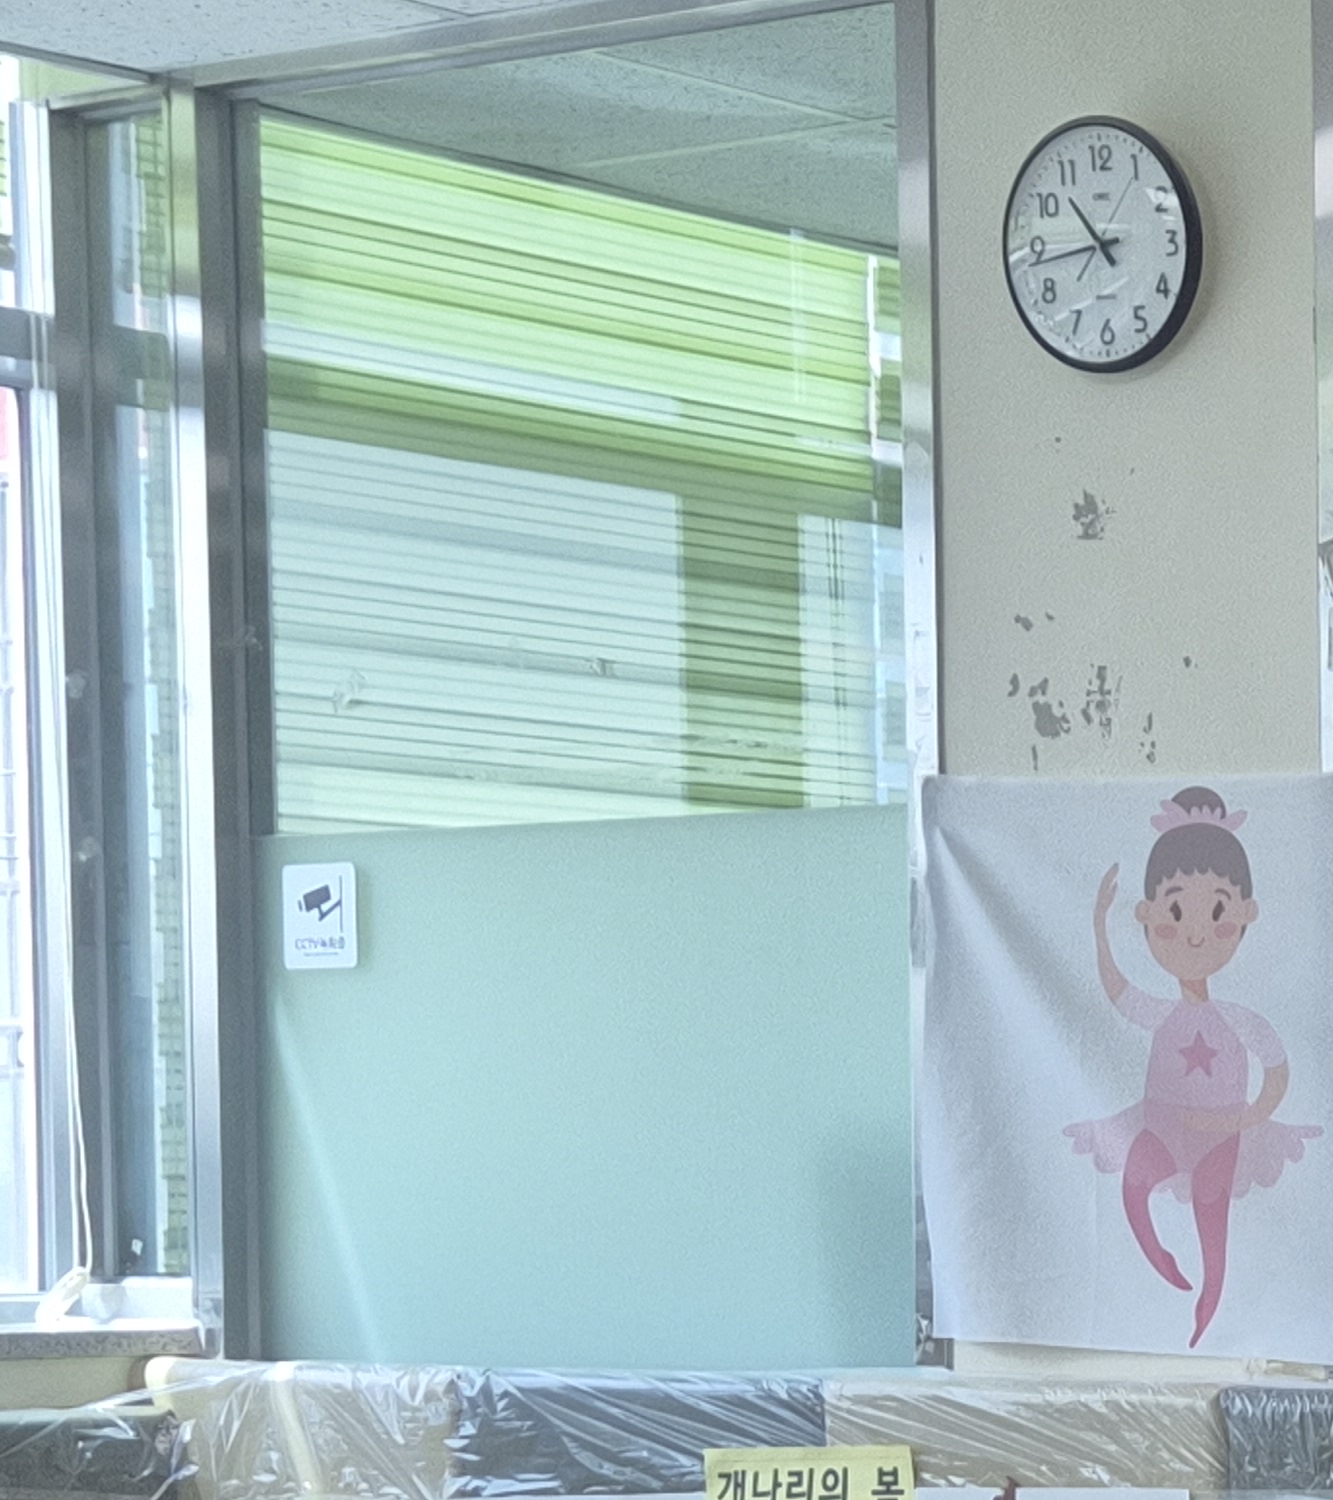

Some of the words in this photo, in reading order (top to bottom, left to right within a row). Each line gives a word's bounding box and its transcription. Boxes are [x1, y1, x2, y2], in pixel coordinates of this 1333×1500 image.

[1088, 144, 1113, 172] 12
[1130, 153, 1139, 181] 1
[1058, 159, 1076, 186] 11
[1037, 192, 1059, 218] 10
[1030, 235, 1045, 265] 9
[1165, 229, 1179, 257] 3
[1041, 277, 1057, 304] 8
[1155, 271, 1170, 300] 4
[1069, 309, 1083, 336] 7
[1100, 318, 1115, 345] 6
[1133, 304, 1148, 333] 5
